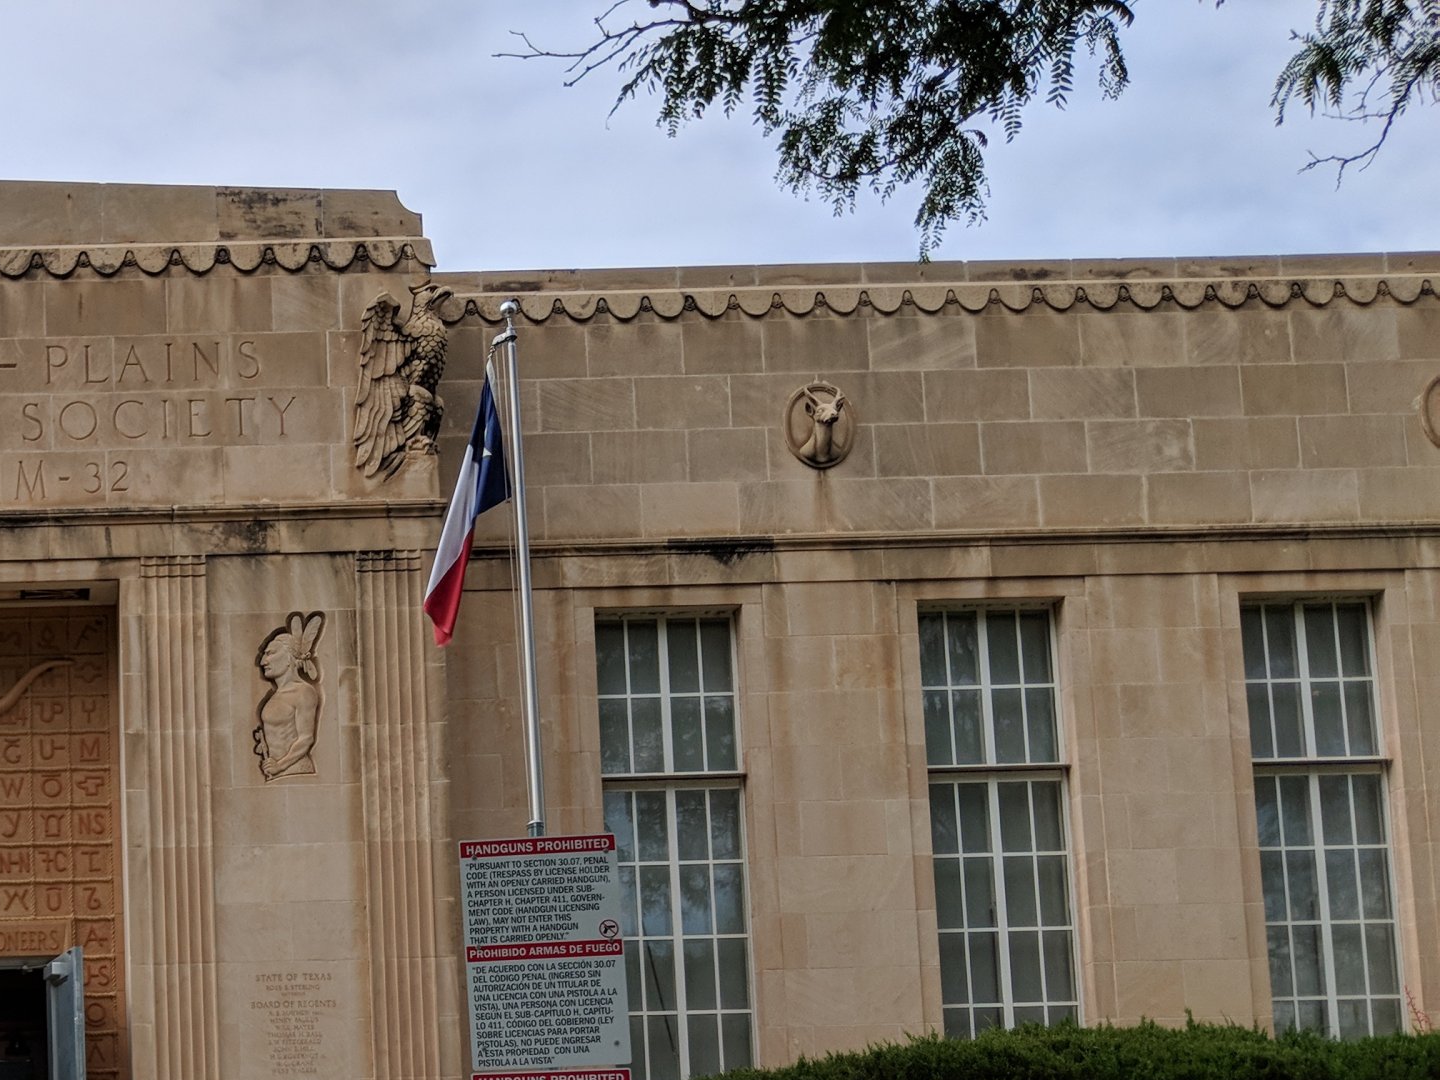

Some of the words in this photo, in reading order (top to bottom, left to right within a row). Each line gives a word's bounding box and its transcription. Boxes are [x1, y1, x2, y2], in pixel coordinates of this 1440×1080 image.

[45, 341, 260, 385] PLAINS
[21, 396, 297, 441] SOCIETY
[466, 842, 533, 855] HANDGUNS
[536, 838, 610, 851] PROHIBITED
[512, 860, 522, 868] TO
[523, 859, 556, 867] SECTION
[583, 856, 608, 864] PENAL
[466, 872, 487, 880] CODE
[545, 867, 577, 876] LICENSE
[579, 865, 610, 874] HOLDER
[475, 889, 505, 898] PERSON
[508, 887, 545, 896] LICENSED
[547, 886, 573, 894] UNDER
[576, 884, 595, 892] SUB-
[469, 908, 489, 917] MENT
[492, 907, 513, 915] CODE
[559, 903, 600, 912] LICENSING
[470, 926, 509, 935] PROPERTY
[511, 925, 531, 933] WITH
[539, 922, 578, 931] HANDGUN
[470, 936, 488, 944] THAT
[500, 934, 534, 943] CARRIED
[470, 948, 526, 958] PROHIBIDO
[529, 946, 566, 955] ARMAS
[569, 945, 583, 953] DE
[585, 943, 620, 952] FUEGO
[476, 1031, 503, 1039] SOBRE
[505, 1029, 545, 1038] LICENCIAS
[547, 1028, 568, 1036] PARA
[570, 1026, 600, 1035] PORTAR
[505, 1047, 550, 1056] PROPIEDAD
[554, 1046, 571, 1054] CON
[573, 1045, 590, 1053] UNA
